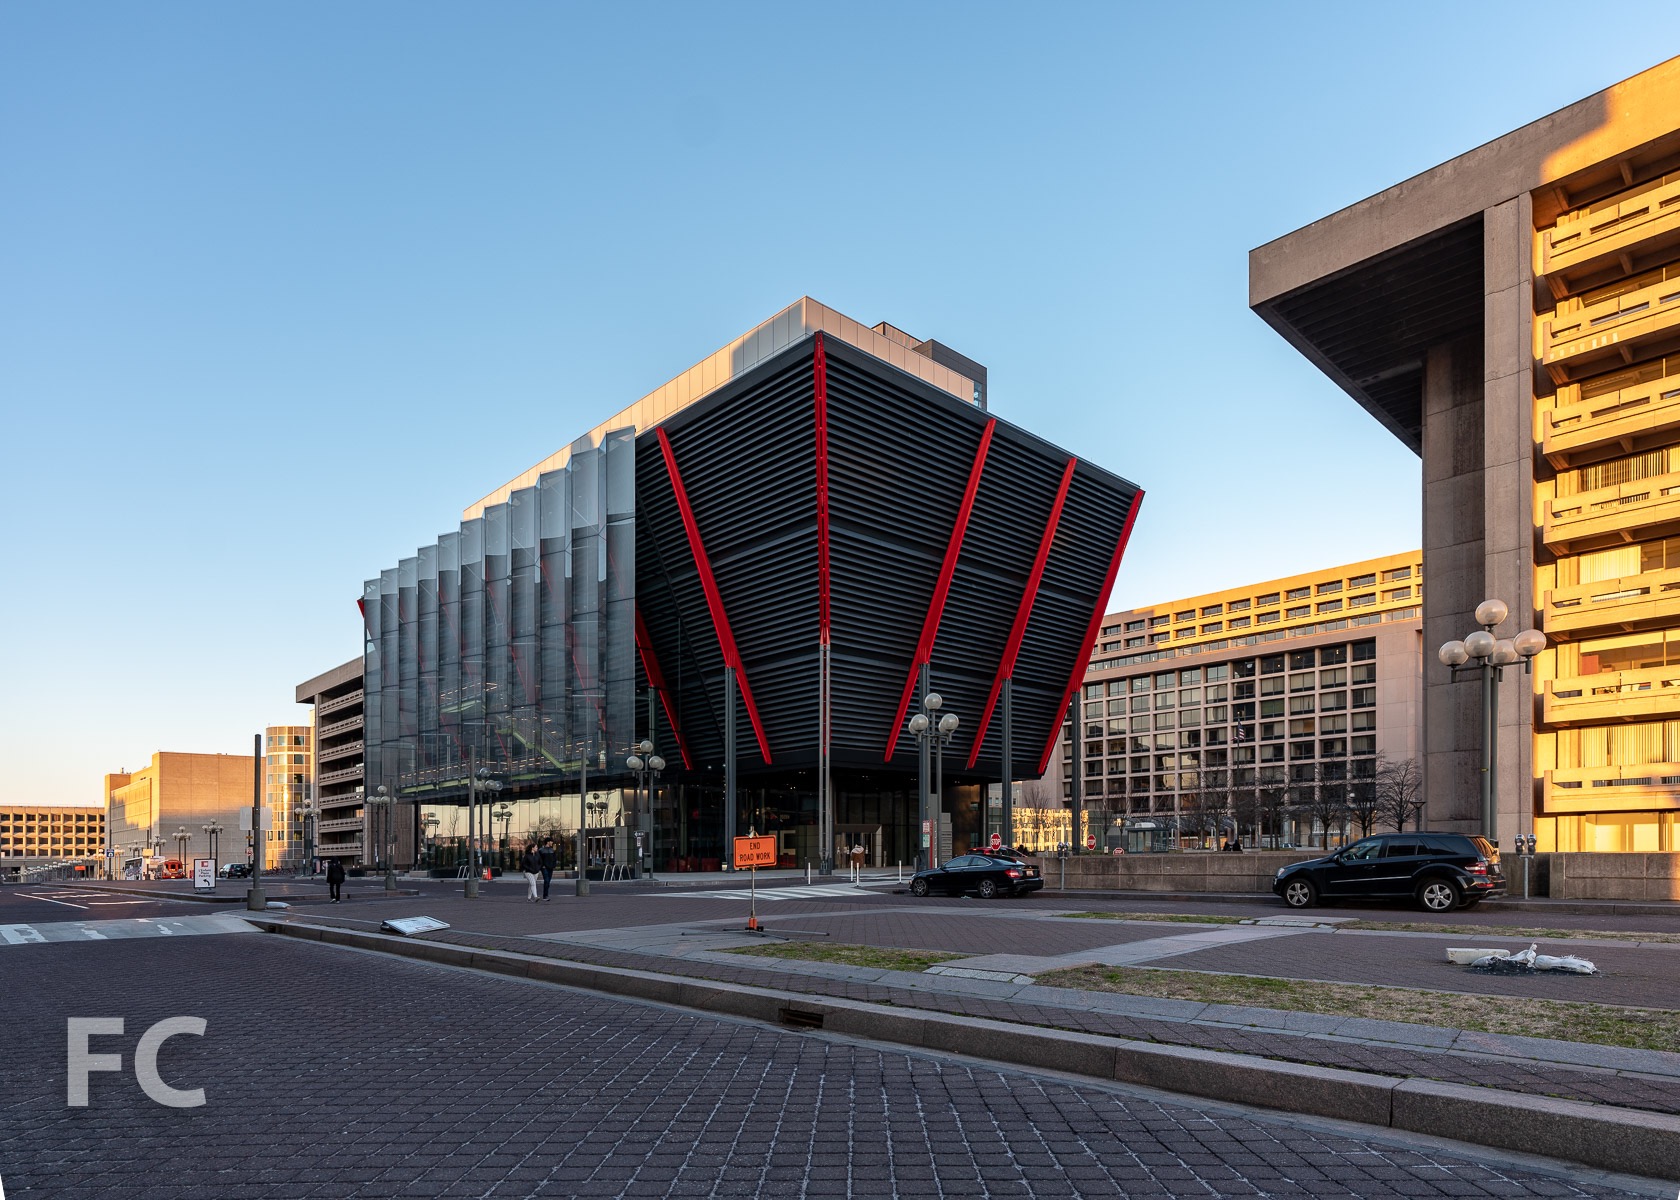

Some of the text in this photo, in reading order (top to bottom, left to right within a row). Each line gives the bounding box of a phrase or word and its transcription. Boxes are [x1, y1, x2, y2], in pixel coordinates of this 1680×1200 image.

[750, 842, 760, 850] END
[991, 838, 1001, 846] STOP
[739, 852, 770, 862] ROAD WORK
